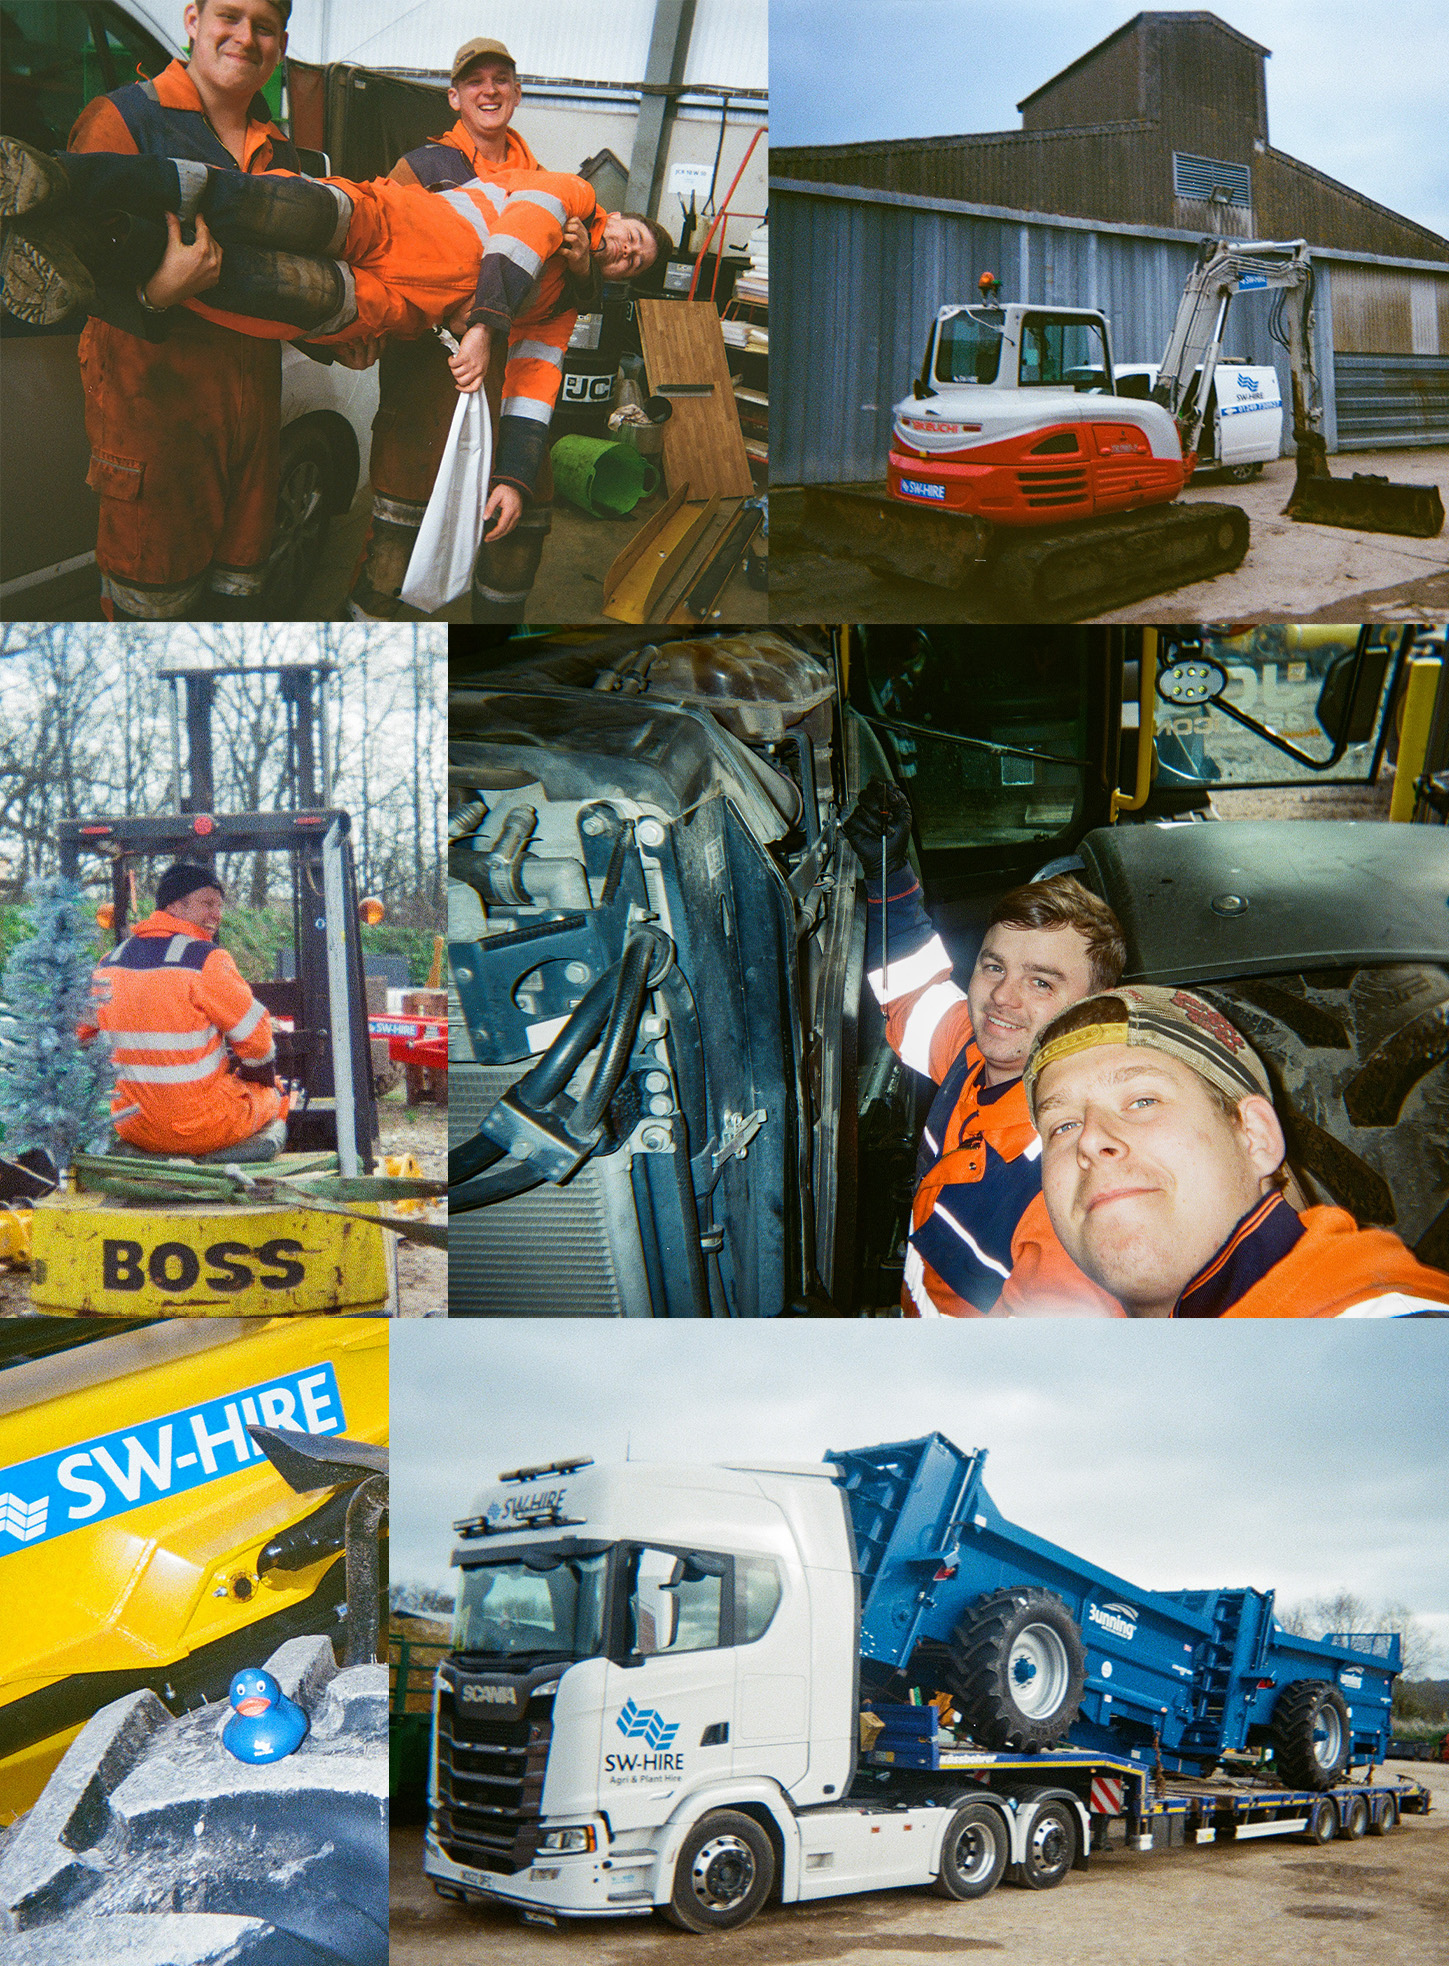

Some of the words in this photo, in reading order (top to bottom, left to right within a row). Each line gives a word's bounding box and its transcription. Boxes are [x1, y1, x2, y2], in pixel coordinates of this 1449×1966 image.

[565, 377, 617, 400] JC
[1236, 392, 1264, 402] SW-HIRE
[908, 481, 945, 499] SW-HIRE
[376, 1022, 416, 1036] SW-HIRE
[102, 1238, 305, 1293] BOSS
[57, 1372, 338, 1520] SW-HIRE
[463, 1685, 517, 1704] SCANIA
[604, 1753, 684, 1772] SW-HIRE
[610, 1776, 629, 1786] Agri
[631, 1775, 638, 1783] &
[640, 1774, 662, 1783] Plant
[664, 1774, 682, 1782] Hire
